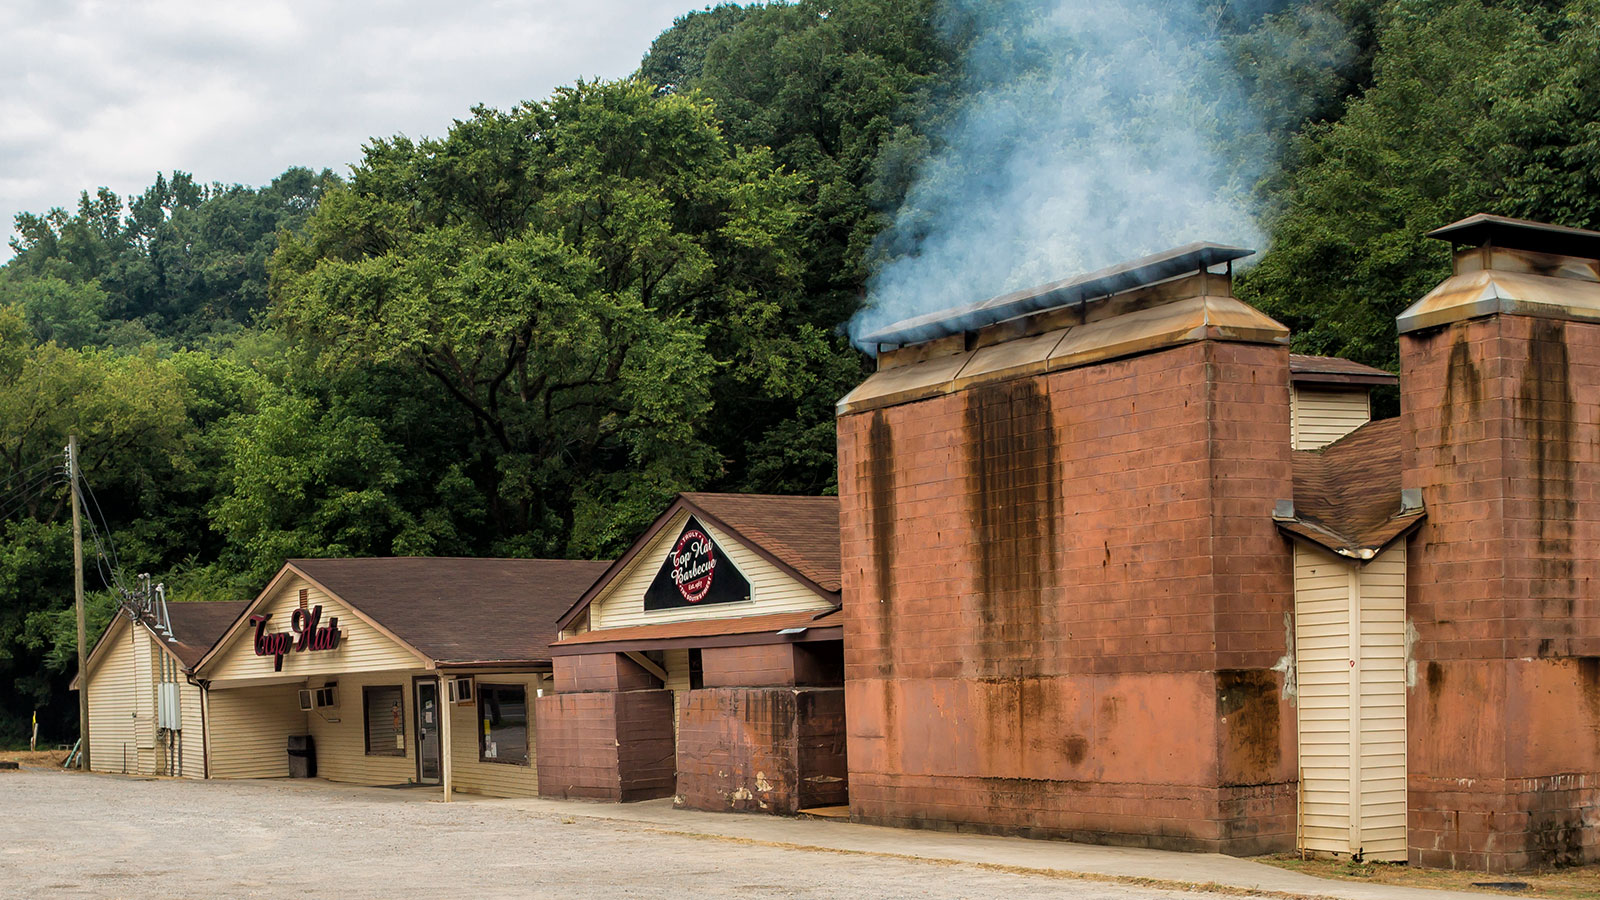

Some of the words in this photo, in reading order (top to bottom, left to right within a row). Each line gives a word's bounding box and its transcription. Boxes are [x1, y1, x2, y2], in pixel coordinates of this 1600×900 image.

[682, 532, 698, 542] TRULY
[670, 549, 692, 568] Top
[691, 537, 713, 558] Hat
[671, 558, 717, 585] Barbecue
[249, 613, 294, 672] Top
[291, 605, 341, 652] Hat
